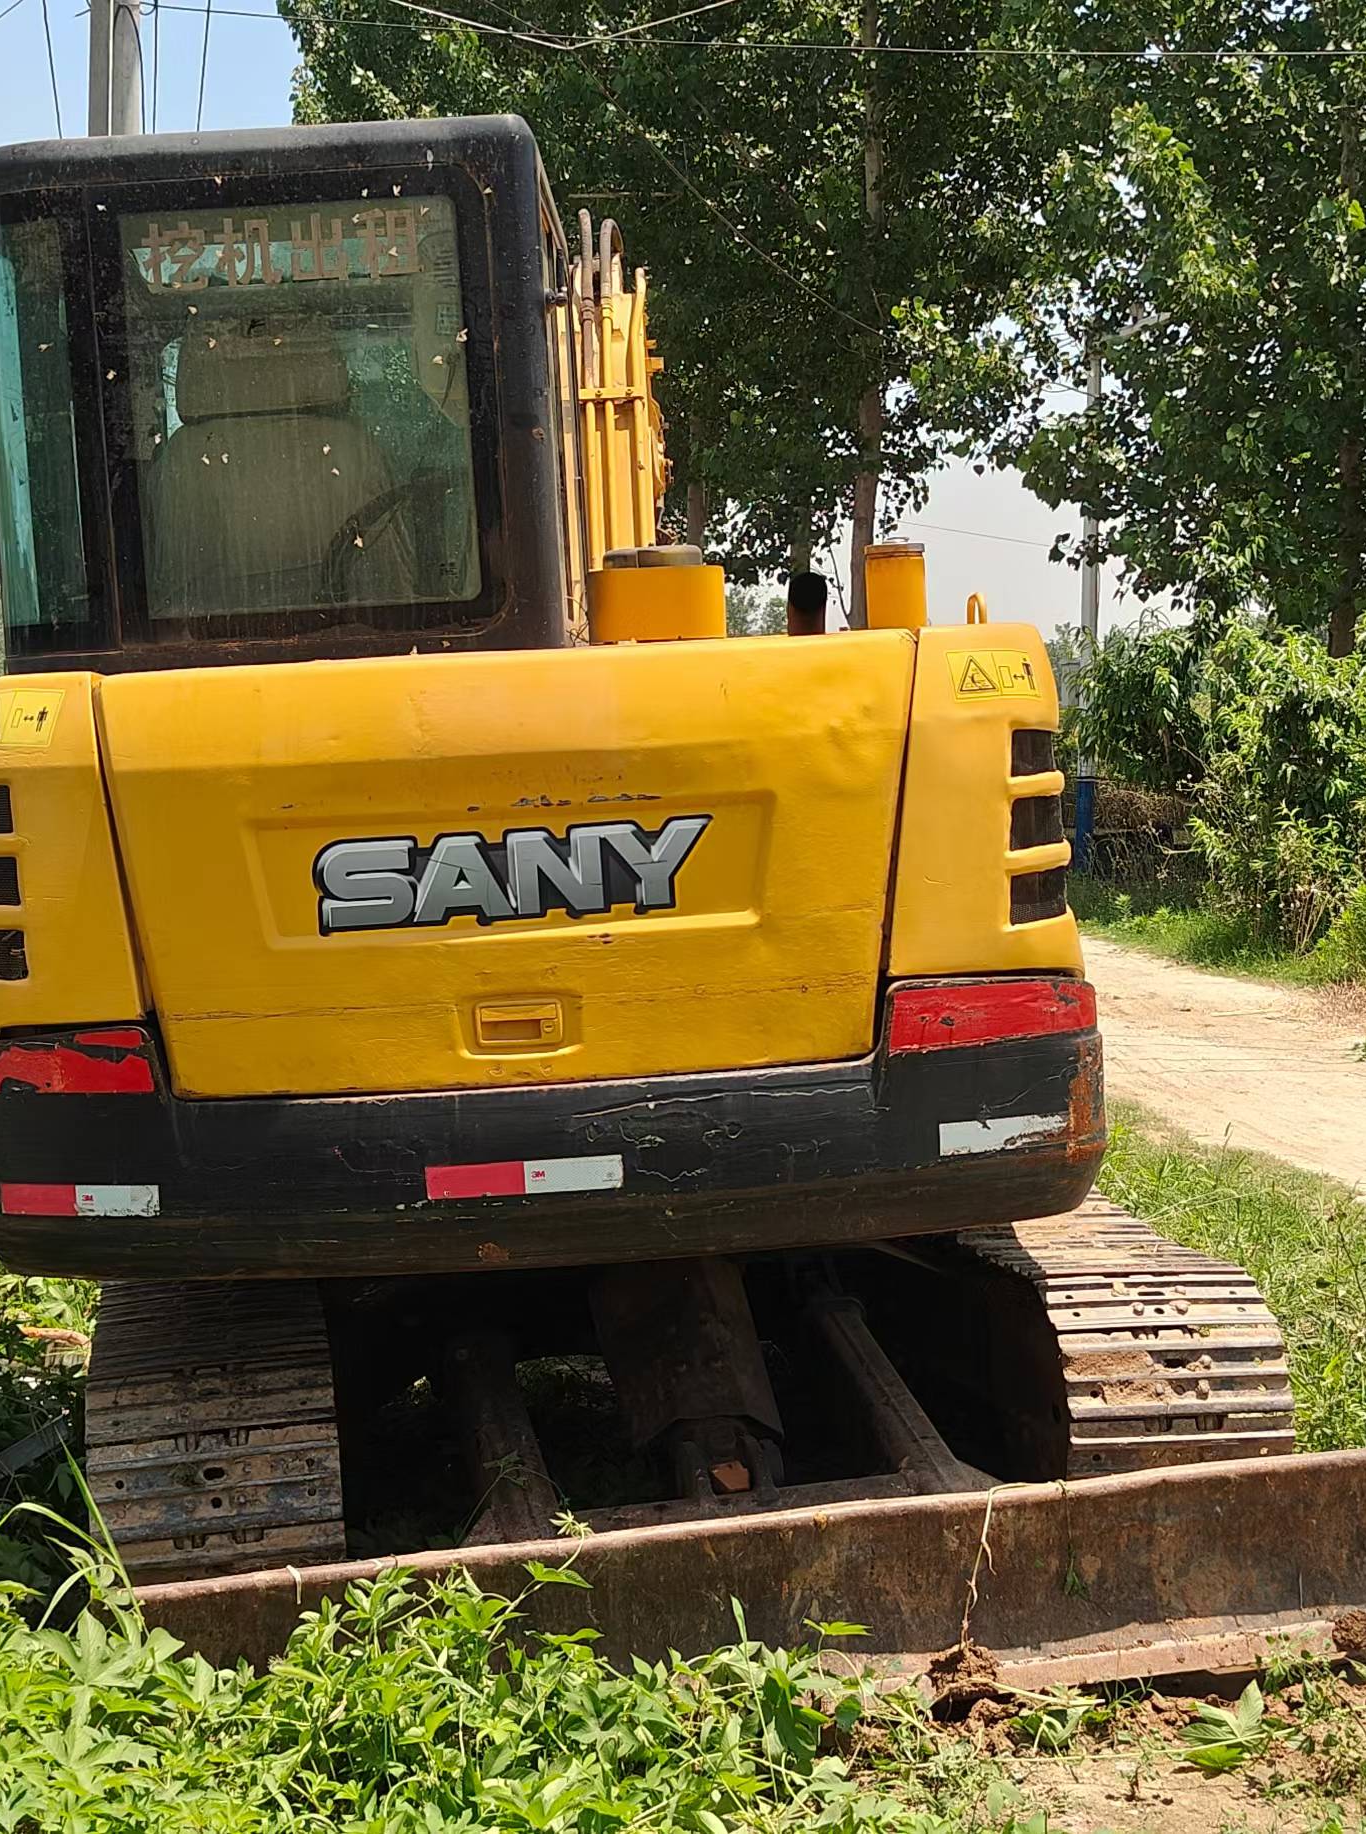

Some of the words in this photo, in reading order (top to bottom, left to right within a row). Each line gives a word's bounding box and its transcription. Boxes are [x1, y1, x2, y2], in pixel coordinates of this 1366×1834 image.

[141, 208, 425, 294] 挖机出租
[313, 815, 713, 934] SANY
[530, 1170, 546, 1179] 3M
